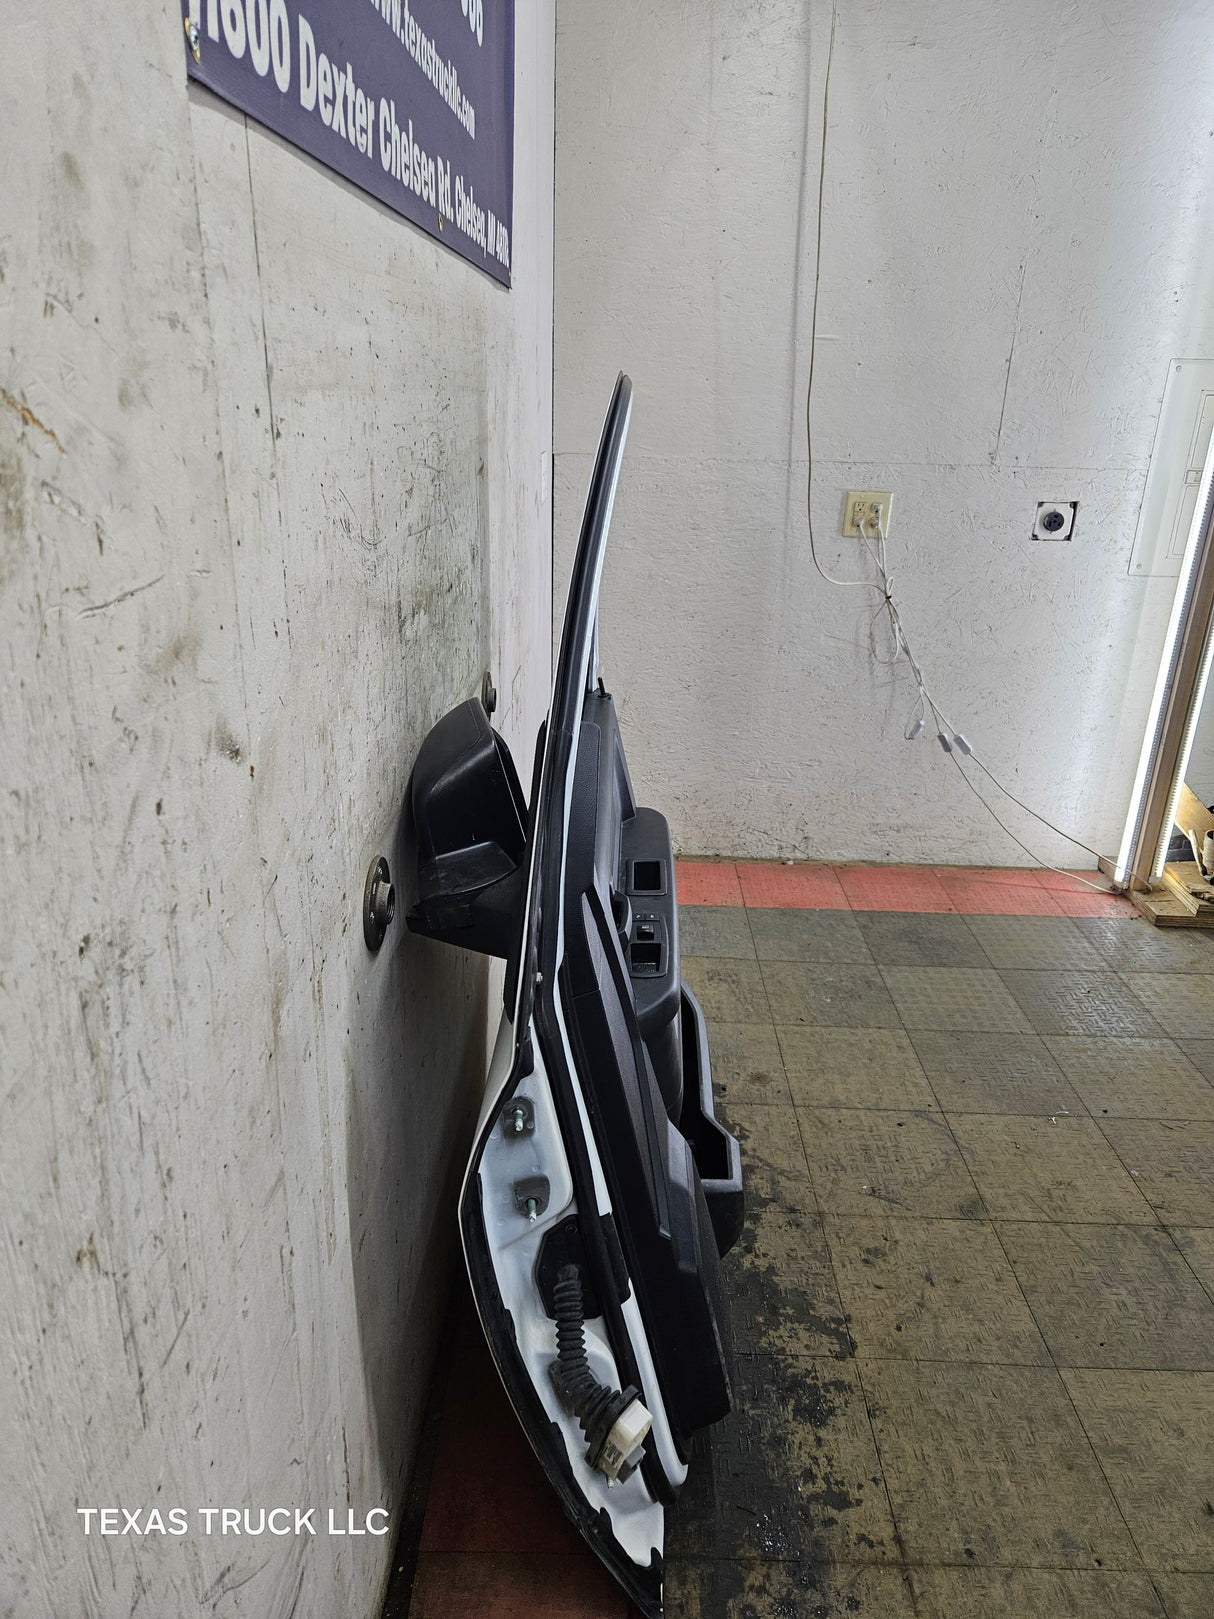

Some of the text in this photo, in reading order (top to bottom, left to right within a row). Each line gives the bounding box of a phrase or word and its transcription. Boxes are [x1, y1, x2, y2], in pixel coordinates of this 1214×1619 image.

[189, 0, 291, 93] 600
[299, 14, 375, 159] Dexter
[379, 97, 436, 209] Chelsea
[437, 155, 454, 223] Rd.
[455, 175, 487, 258] Chelsea,
[368, 0, 475, 140] w.texastruckllc.com
